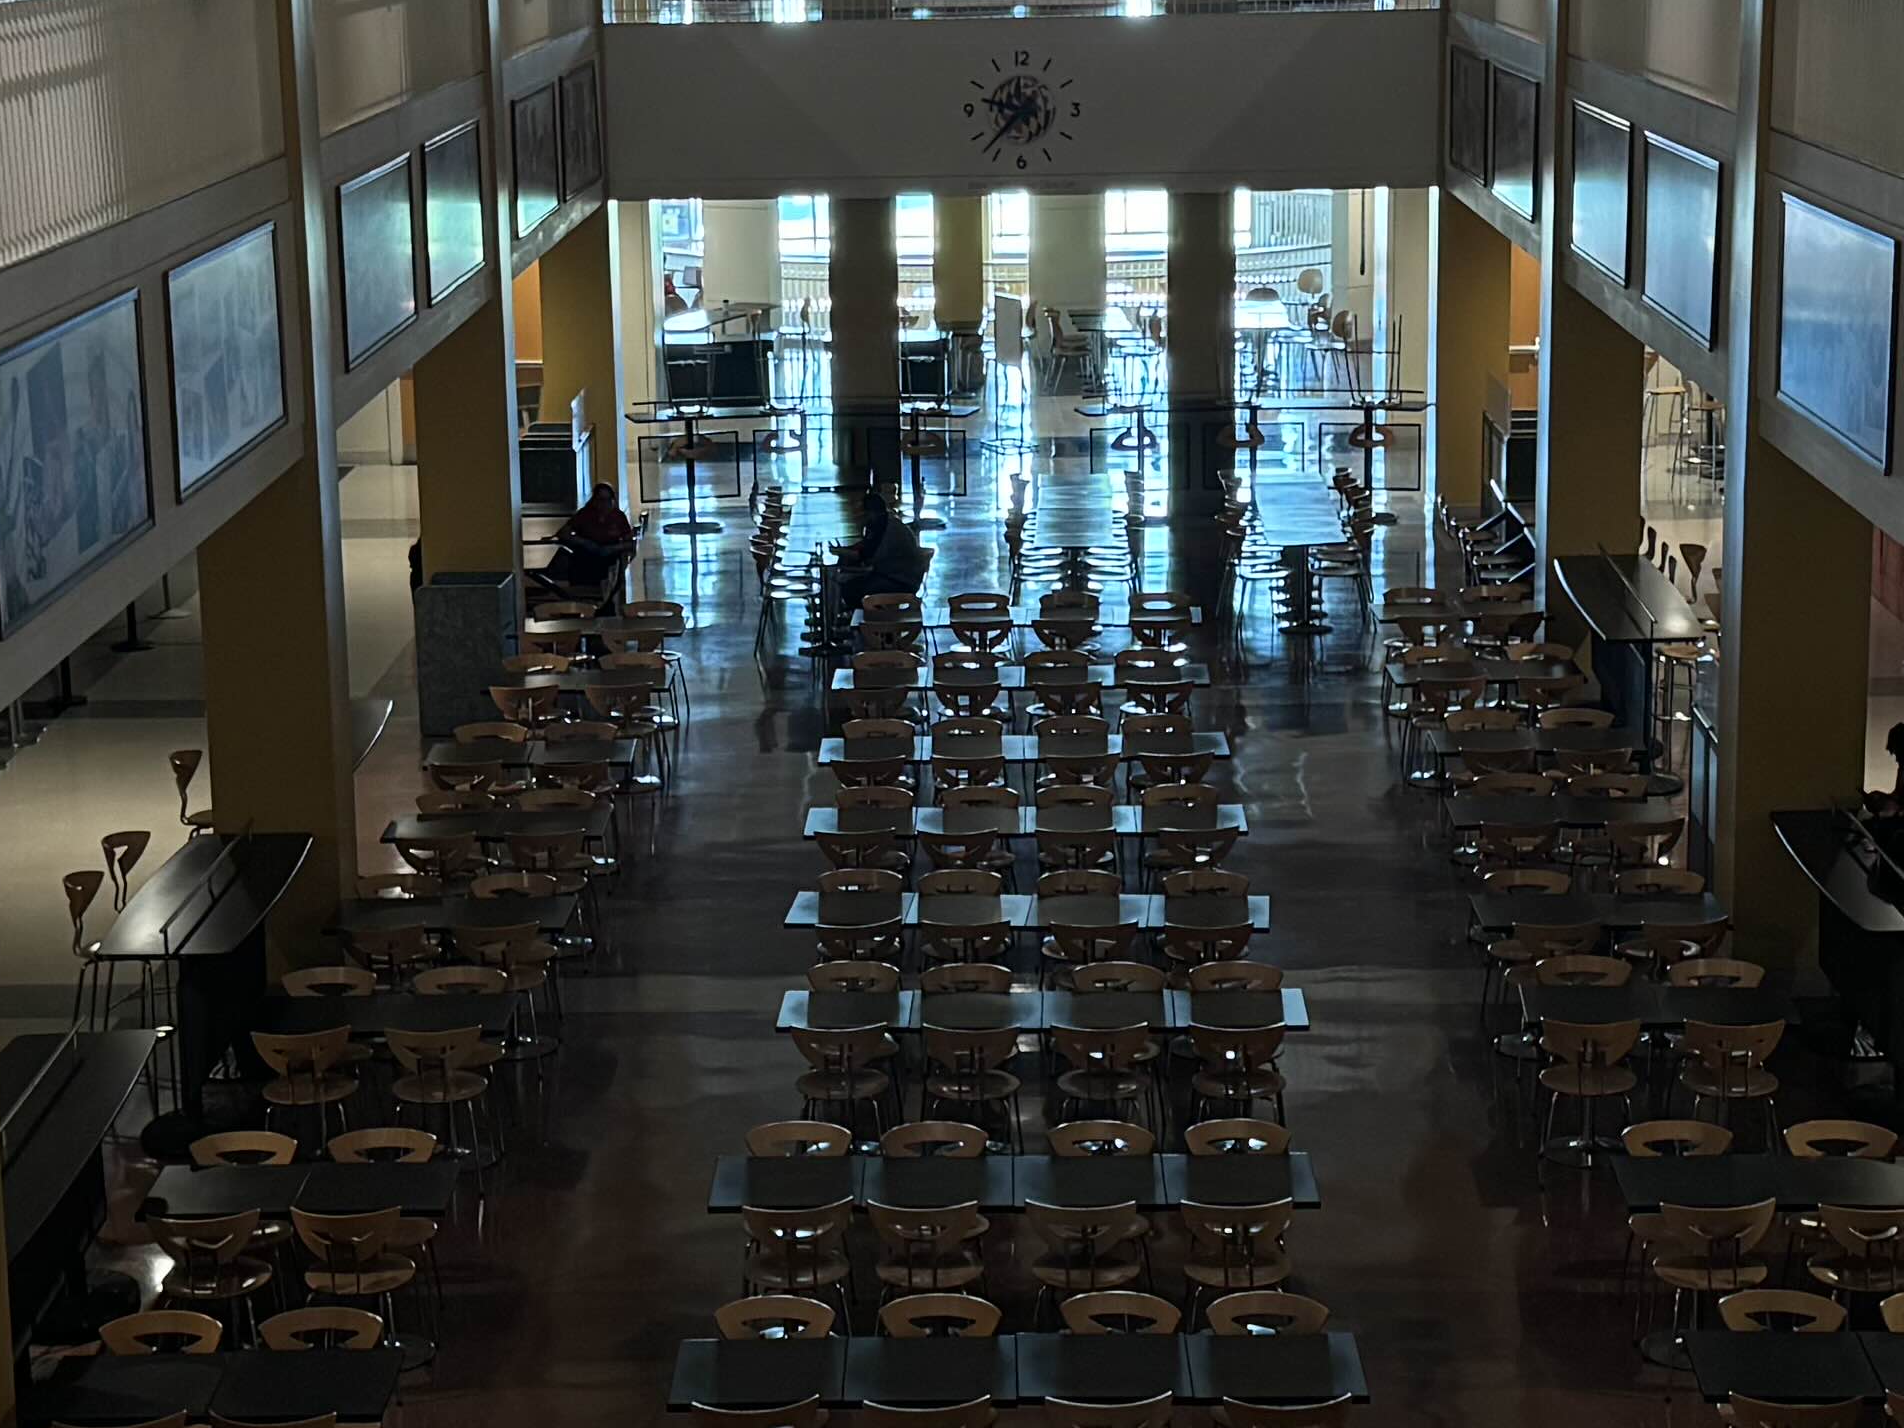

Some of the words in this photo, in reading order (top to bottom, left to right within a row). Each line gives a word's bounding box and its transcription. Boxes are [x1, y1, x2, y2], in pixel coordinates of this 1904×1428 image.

[1014, 51, 1030, 66] 12
[963, 103, 974, 117] 9
[1070, 102, 1081, 117] 3
[1016, 155, 1027, 170] 6
